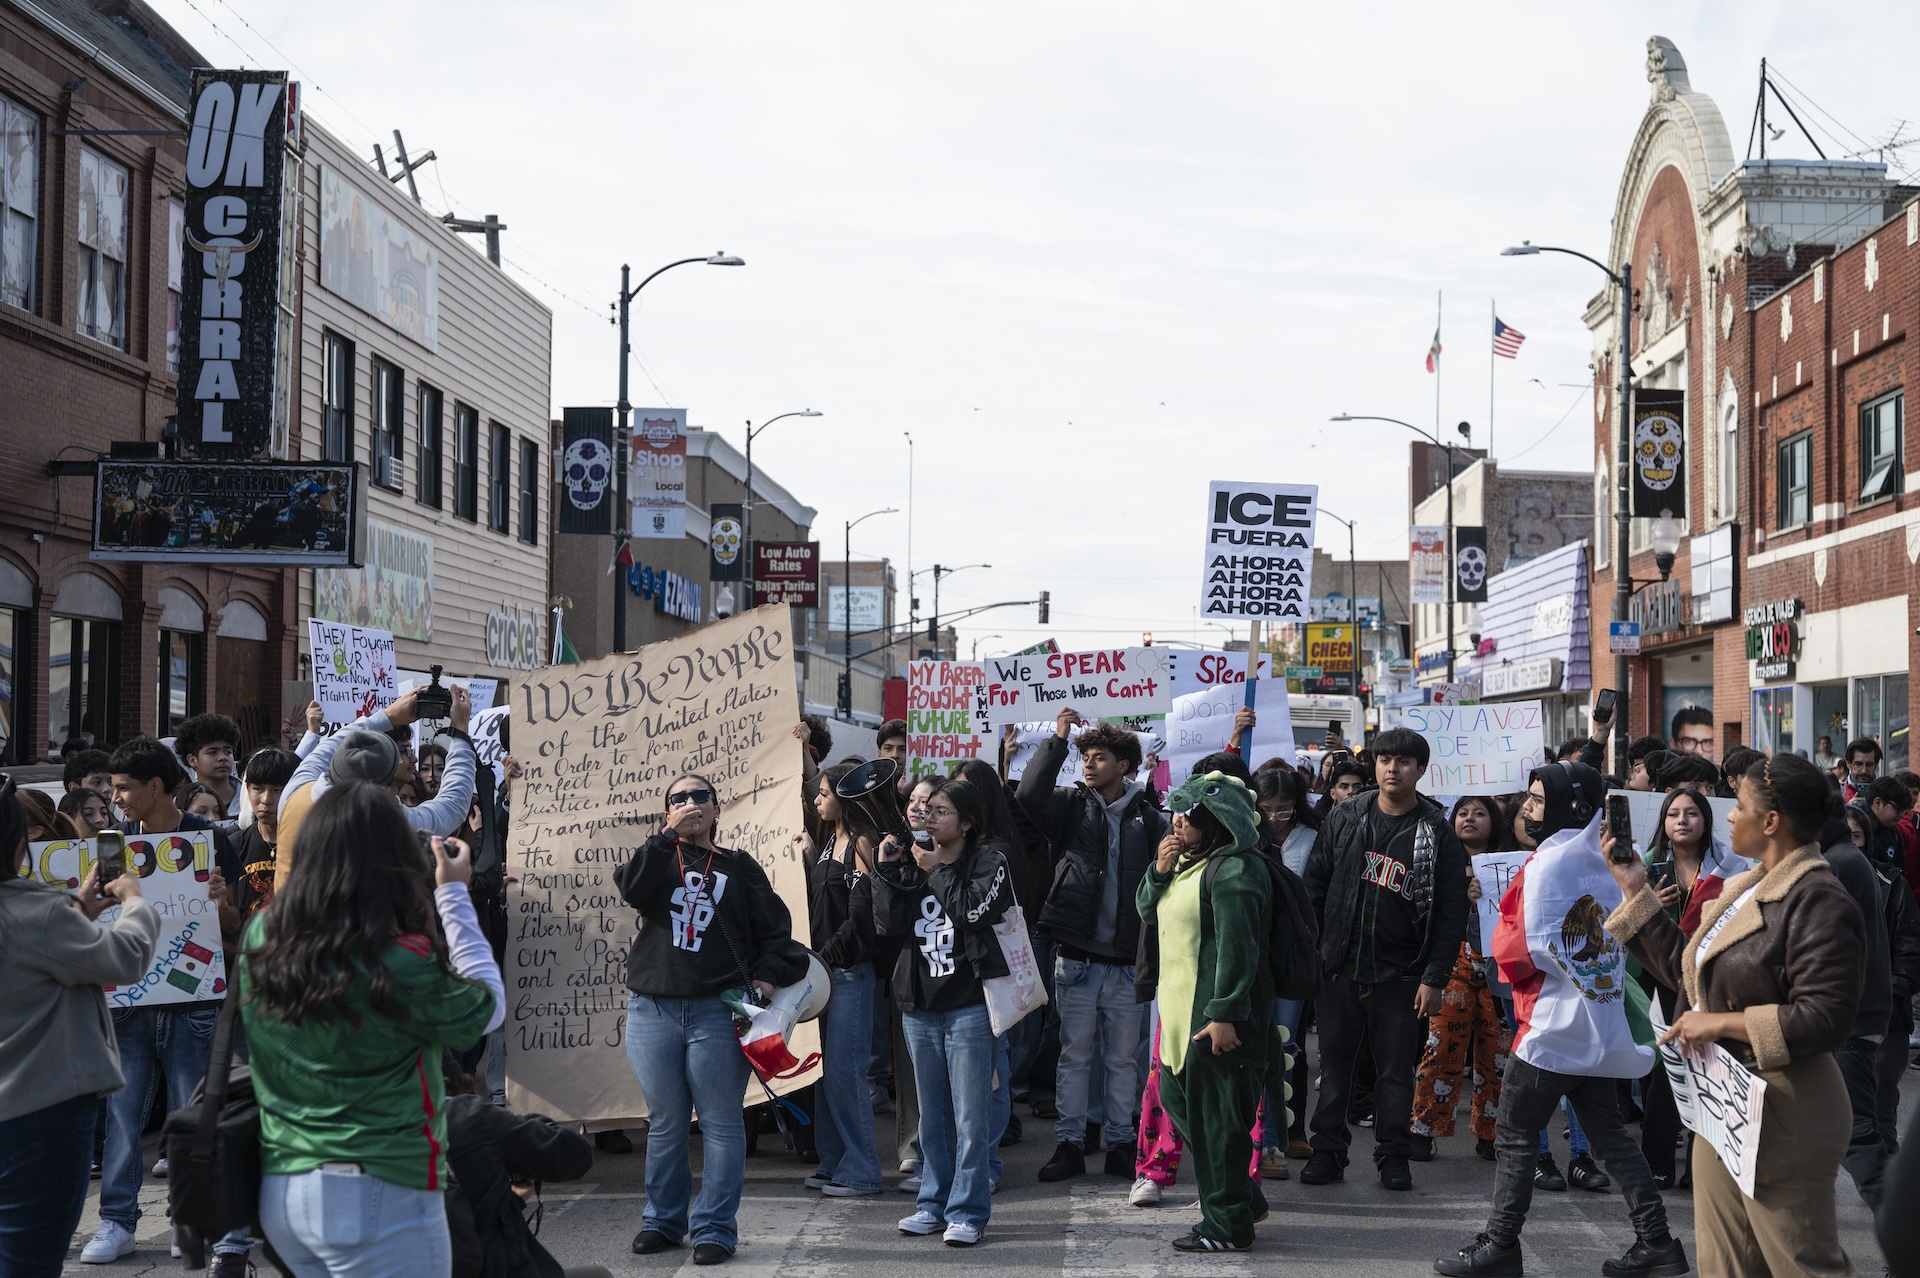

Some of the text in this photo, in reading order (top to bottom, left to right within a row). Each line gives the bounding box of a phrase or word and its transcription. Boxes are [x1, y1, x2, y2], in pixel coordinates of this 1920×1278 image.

[186, 81, 283, 189] OK
[194, 195, 248, 443] CORRAL
[636, 450, 684, 470] Shop
[161, 472, 288, 495] OK CORRAL
[655, 482, 684, 491] Local
[1213, 491, 1312, 528] ICE
[760, 546, 811, 559] Low Auto
[1210, 528, 1309, 549] FUERA
[377, 527, 429, 580] WARRIORS
[769, 559, 802, 572] Rates
[1209, 555, 1305, 571] AHORA
[1413, 551, 1443, 563] Shop
[755, 580, 816, 594] Bajas Tarifas
[1208, 570, 1304, 587] AHORA
[664, 570, 702, 624] EZPAWN
[767, 591, 803, 603] de Auto
[1206, 599, 1302, 617] AHORA
[1207, 585, 1303, 602] AHORA
[1744, 598, 1796, 626] AGENCIA DE VIAJES
[311, 621, 394, 652] THEY FOUGHT
[488, 599, 541, 668] cricket
[1745, 623, 1791, 660] MEXICO
[314, 647, 364, 671] FOR OUR
[909, 661, 936, 686] MY
[994, 650, 1126, 682] We SPEAK
[315, 666, 394, 689] FUTURE NOW WE
[517, 675, 600, 726] We
[667, 625, 787, 709] People
[319, 684, 350, 702] FIGHT
[907, 685, 973, 710] fought
[988, 683, 1020, 707] For
[1028, 682, 1067, 703] Those
[1072, 683, 1098, 700] Who
[1106, 677, 1158, 698] Can't
[539, 682, 779, 758] of the United States,
[1408, 706, 1541, 733] SOY LA VOZ
[524, 711, 767, 783] in Order to form a more
[1179, 729, 1203, 747] Bite
[1435, 735, 1517, 758] DE MI
[524, 725, 766, 805] perfect Union, establish
[1429, 756, 1537, 788] AMILIA
[752, 773, 778, 805] for
[518, 793, 600, 822] Justice,
[605, 787, 665, 806] insure
[517, 847, 558, 869] the
[520, 890, 554, 914] and
[782, 834, 798, 862] of
[520, 864, 604, 897] promote
[1361, 850, 1416, 901] XICO
[966, 865, 1006, 923] adidas
[516, 911, 619, 950] Liberty to
[112, 920, 201, 1008] Deportation
[517, 946, 562, 968] our
[518, 961, 628, 989] and establi
[514, 989, 629, 1022] Constituti
[514, 1016, 595, 1051] United
